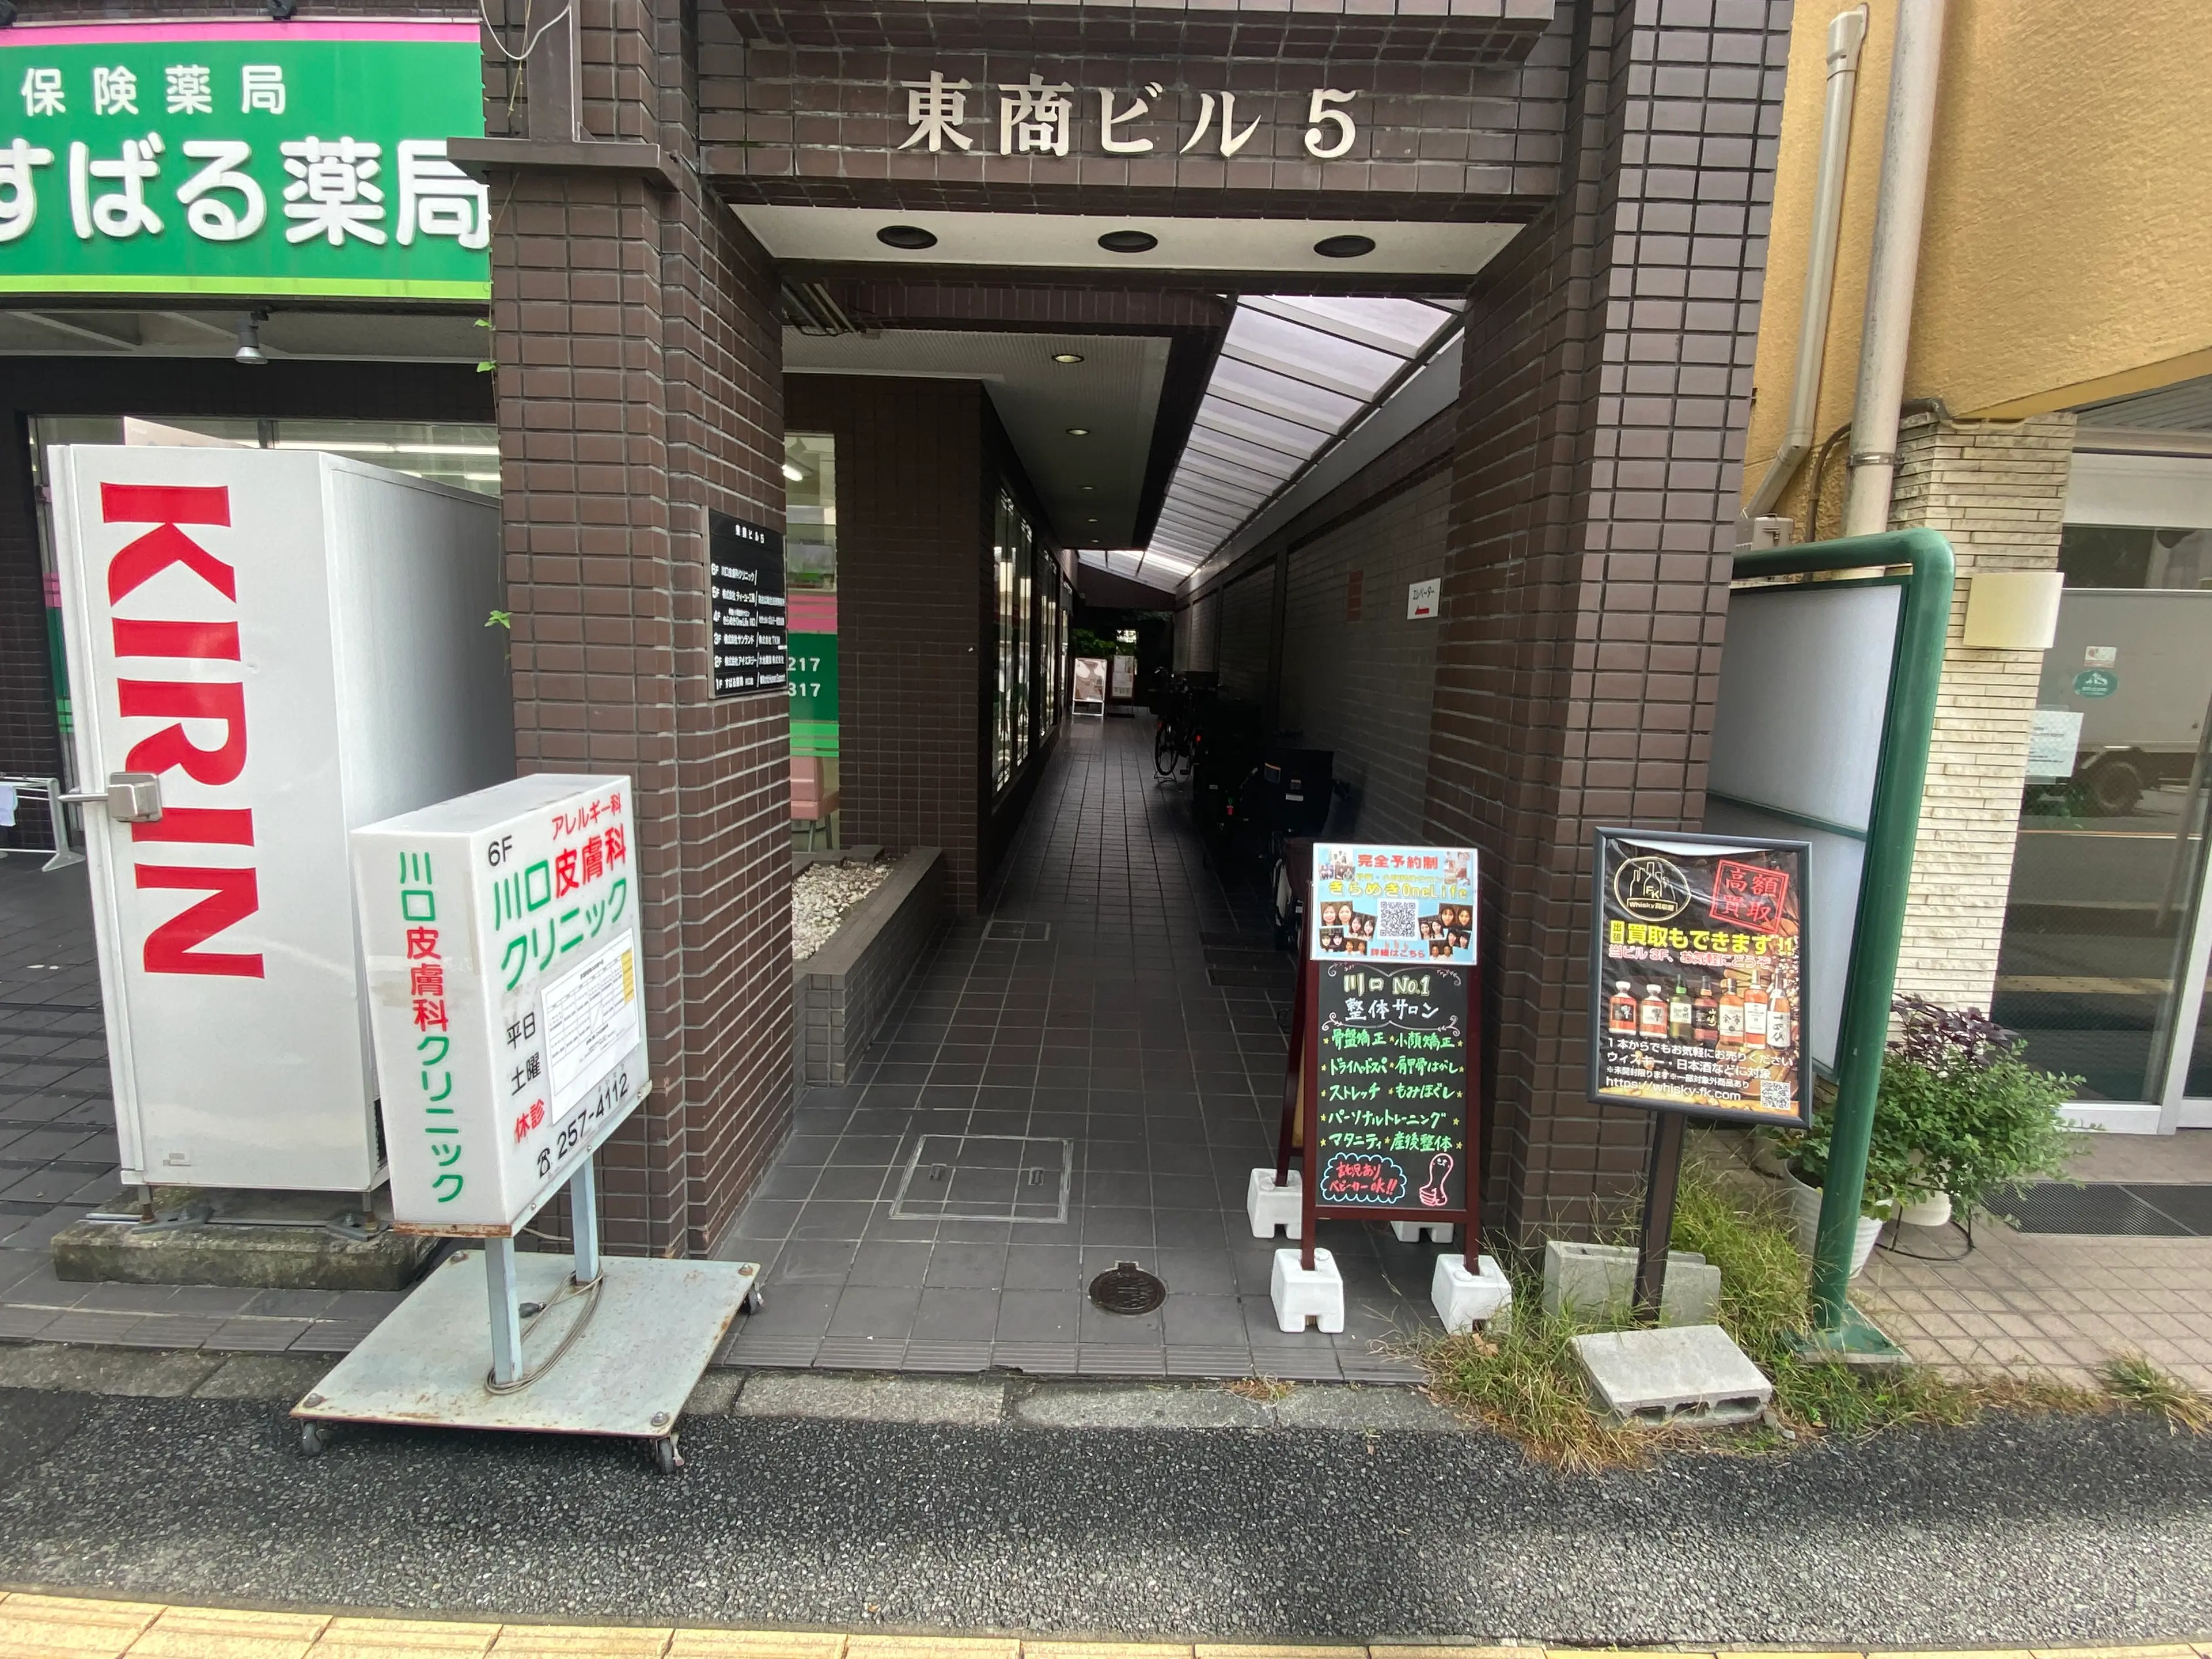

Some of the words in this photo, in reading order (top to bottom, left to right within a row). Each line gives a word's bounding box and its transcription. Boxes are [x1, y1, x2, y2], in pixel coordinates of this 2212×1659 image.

[21, 65, 287, 117] 保険薬局
[100, 482, 265, 979] KIRIN
[552, 793, 621, 840] アレルギー科
[488, 835, 512, 867] 6F
[1357, 854, 1439, 870] 完全予約制
[494, 823, 626, 931] 川口皮膚科
[1726, 867, 1779, 897] 高額
[1721, 894, 1771, 922] 買取
[501, 877, 626, 991] クリニック
[1370, 948, 1426, 959] 詳細はこちら
[1343, 972, 1384, 997] 川口
[1392, 975, 1430, 997] No.1
[1345, 997, 1439, 1021] 整体サロン
[400, 851, 464, 1203] 川口皮膚科クリニック
[507, 1012, 535, 1049] 平日
[1332, 1028, 1387, 1050] 骨盤矯正
[1394, 1031, 1455, 1051] 小顔矯正
[511, 1052, 541, 1096] 土曜
[1331, 1057, 1388, 1075] ドライヘッドスパ
[1395, 1055, 1459, 1075] 肩甲骨はがし
[1329, 1082, 1380, 1101] ストレッチ
[1395, 1082, 1455, 1099] もみほぐし
[1605, 1075, 1741, 1101] https://whisky-fk.com
[514, 1099, 545, 1143] 休診
[557, 1073, 628, 1160] 257-4112
[1328, 1109, 1446, 1128] パーソナルトレーニング
[1329, 1132, 1381, 1150] マタニティ
[1390, 1131, 1452, 1152] 産後整体
